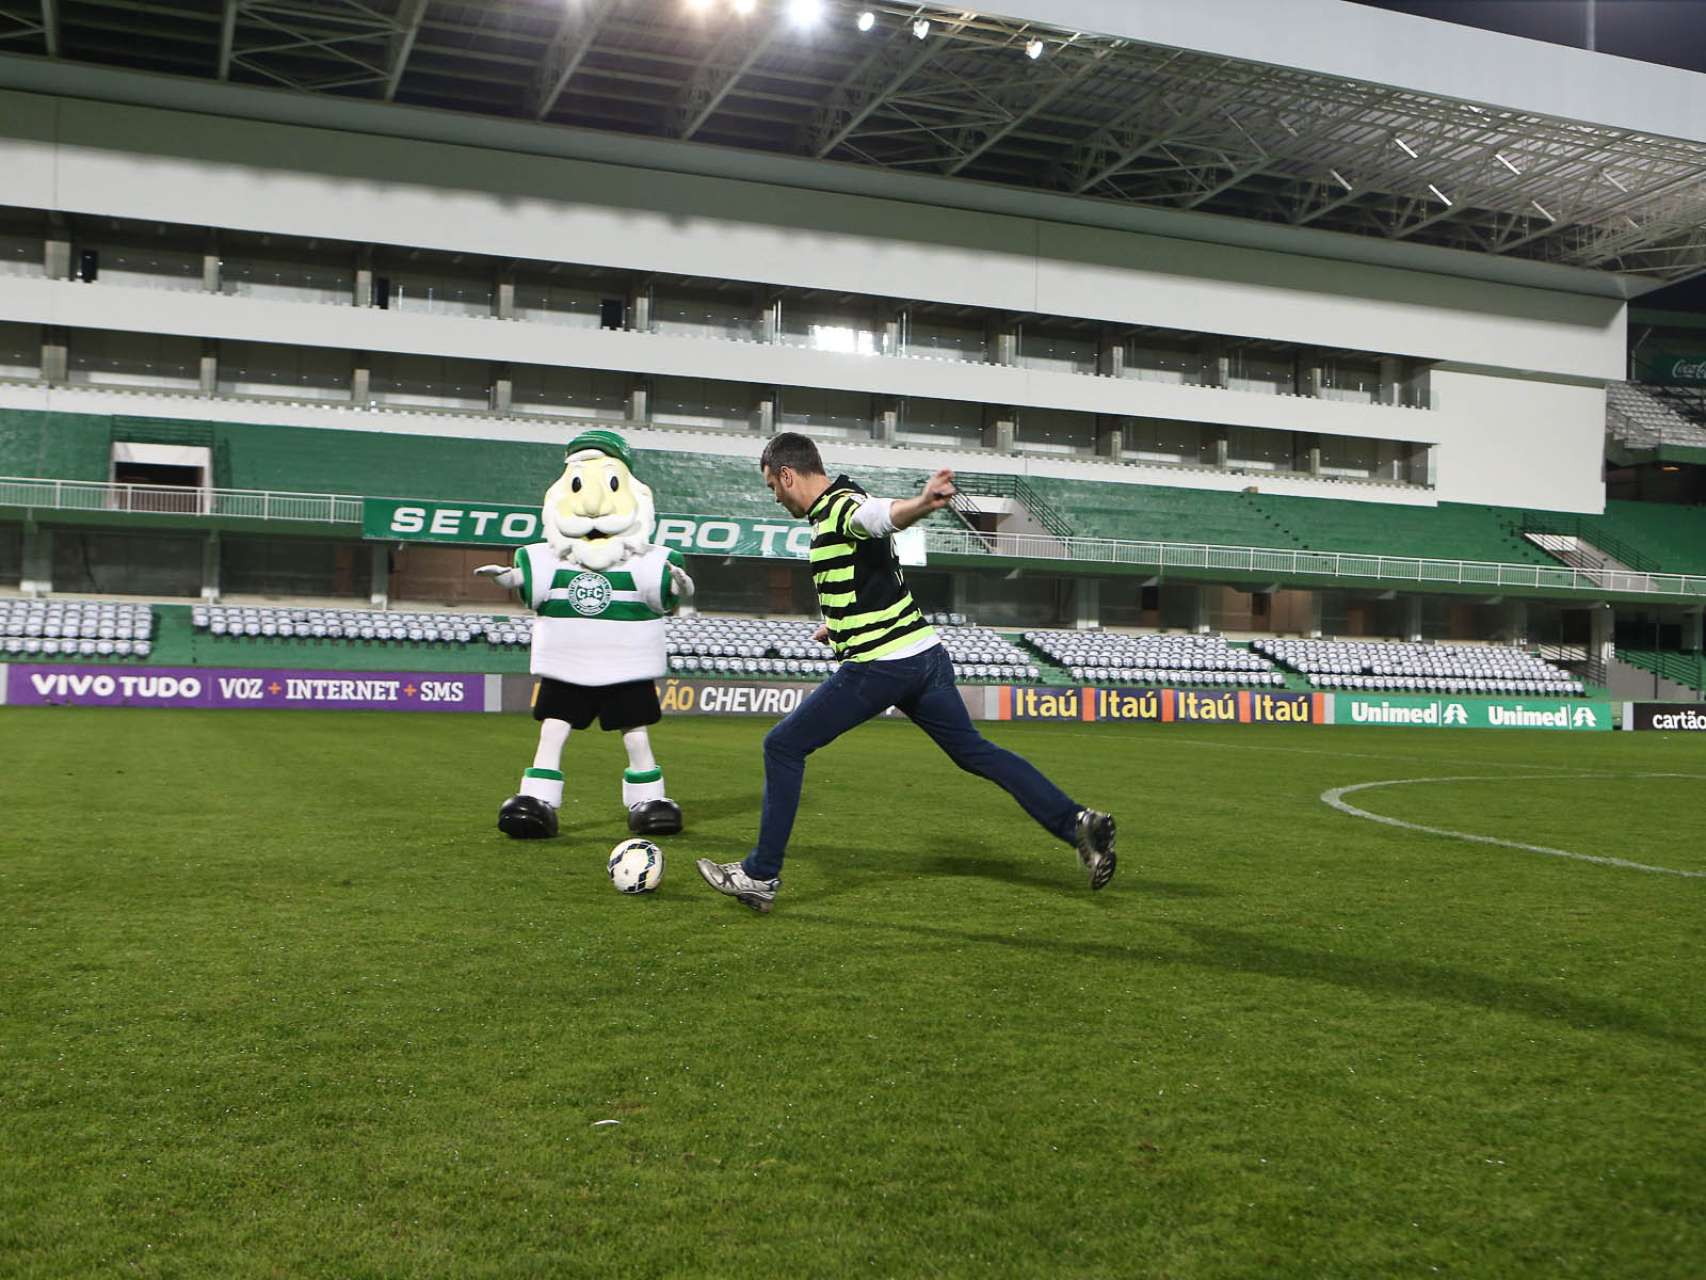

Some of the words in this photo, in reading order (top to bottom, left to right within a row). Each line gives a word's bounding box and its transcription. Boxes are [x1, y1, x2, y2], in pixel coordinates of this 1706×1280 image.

[390, 506, 547, 539] SETO
[577, 588, 603, 599] CFC
[31, 673, 115, 697] VIVO
[119, 676, 201, 698] TUDO
[218, 678, 264, 699] VOZ
[286, 679, 399, 701] INTERNET
[420, 681, 464, 702] SMS
[1016, 688, 1077, 717] Itaú
[1100, 690, 1157, 718] Itaú
[1178, 692, 1235, 720] Itaú
[1255, 693, 1308, 722] Itaú
[1351, 701, 1437, 724] Unimed
[1488, 703, 1568, 728] Unimed
[1652, 710, 1706, 730] cartão
